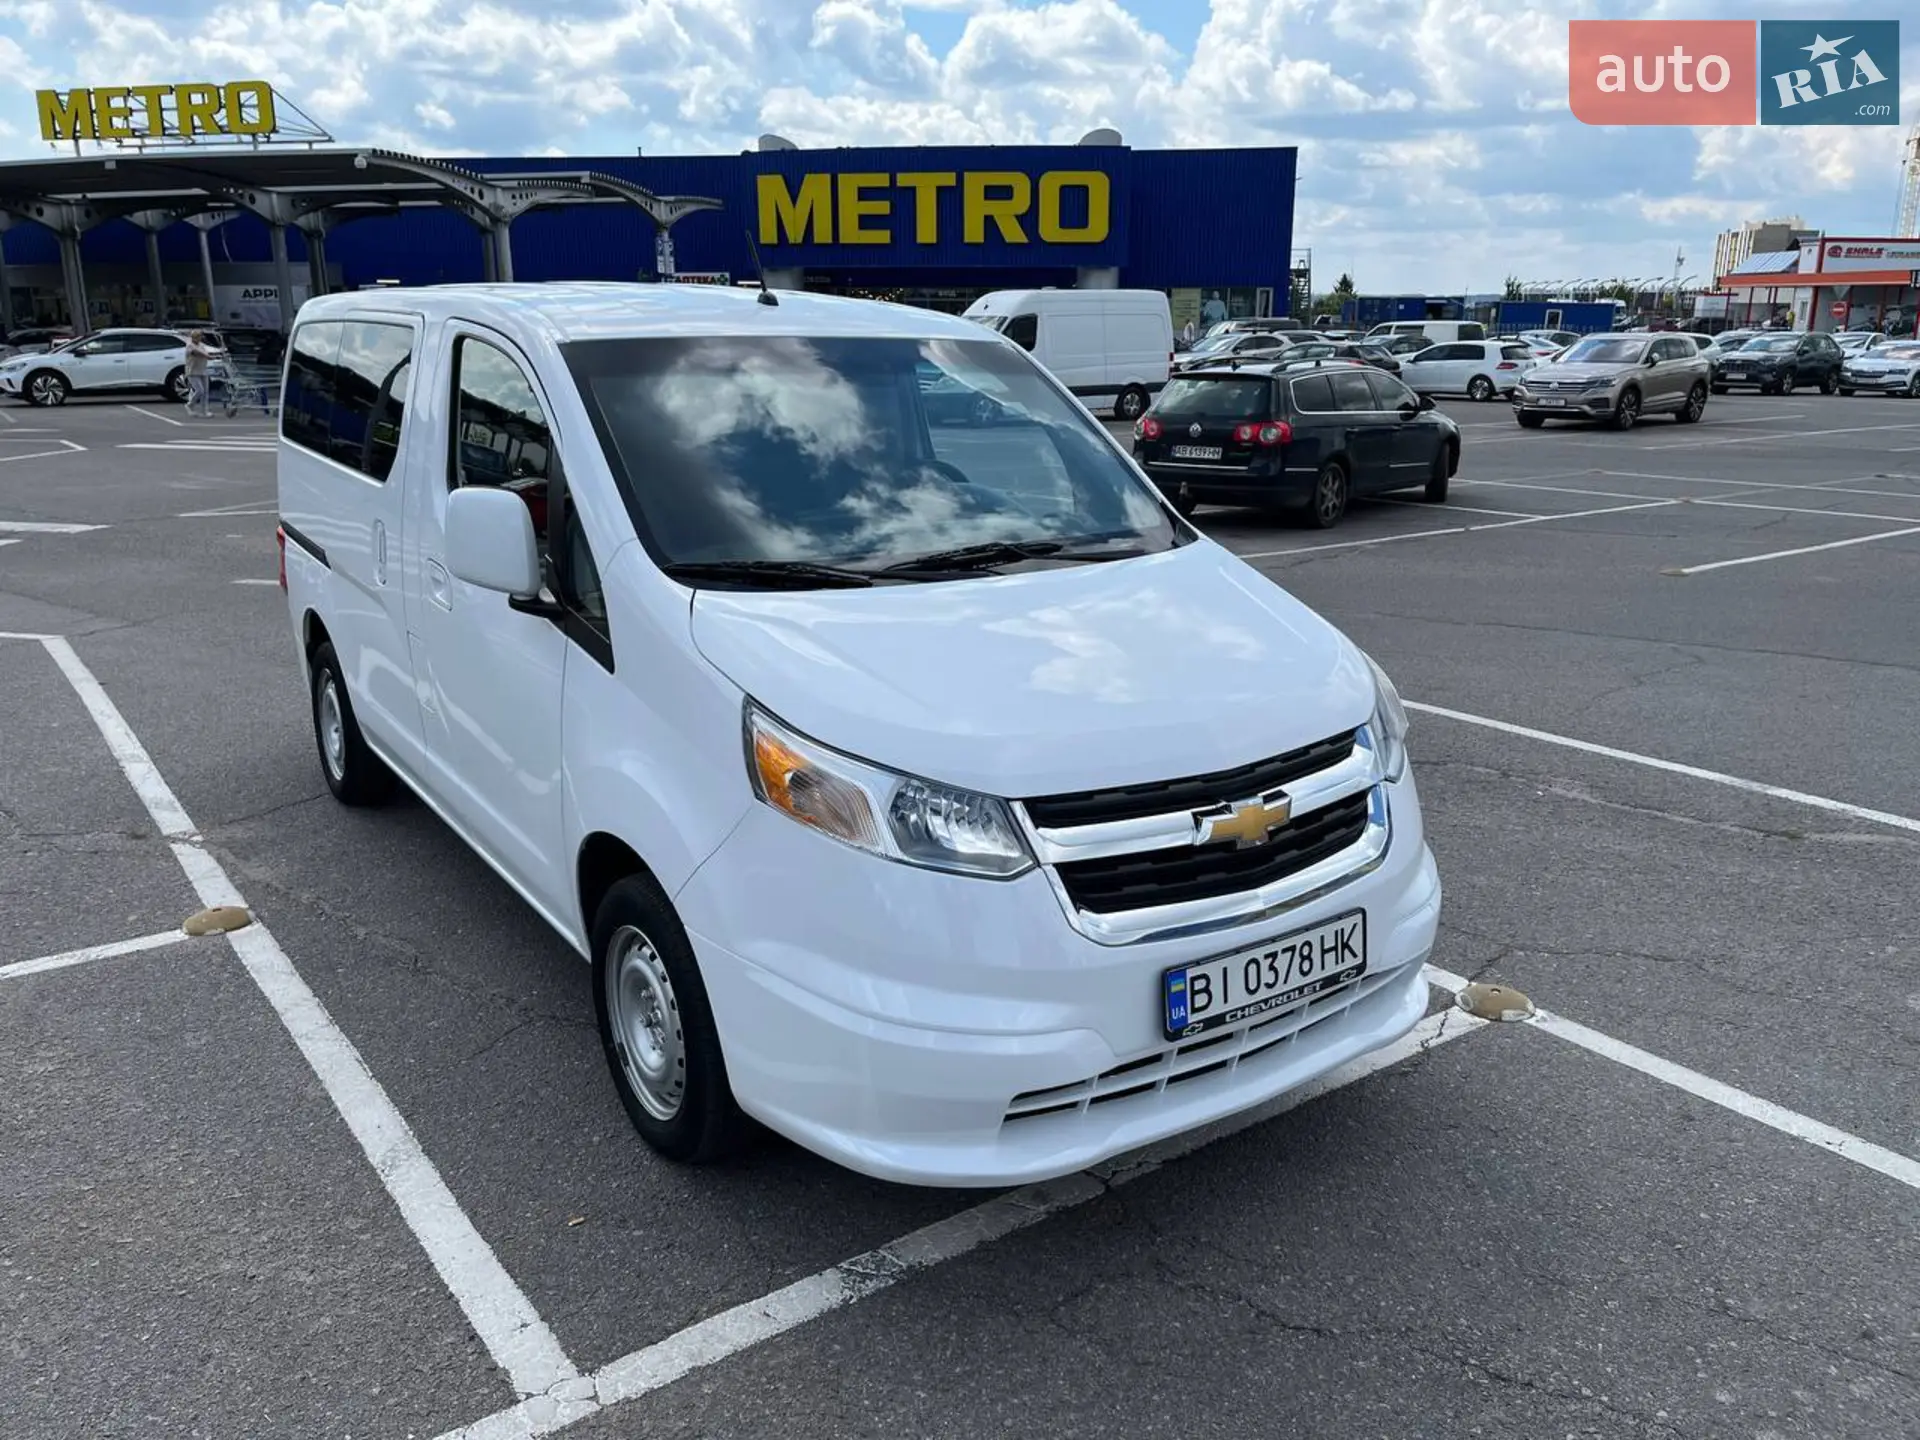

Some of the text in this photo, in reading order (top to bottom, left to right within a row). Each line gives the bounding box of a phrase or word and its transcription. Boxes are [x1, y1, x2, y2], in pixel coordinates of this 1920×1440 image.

[36, 80, 276, 140] METRO
[756, 170, 1111, 244] METRO
[1171, 1006, 1186, 1020] UA
[1190, 966, 1228, 1016] BI
[1225, 981, 1324, 1023] CHEVROLET
